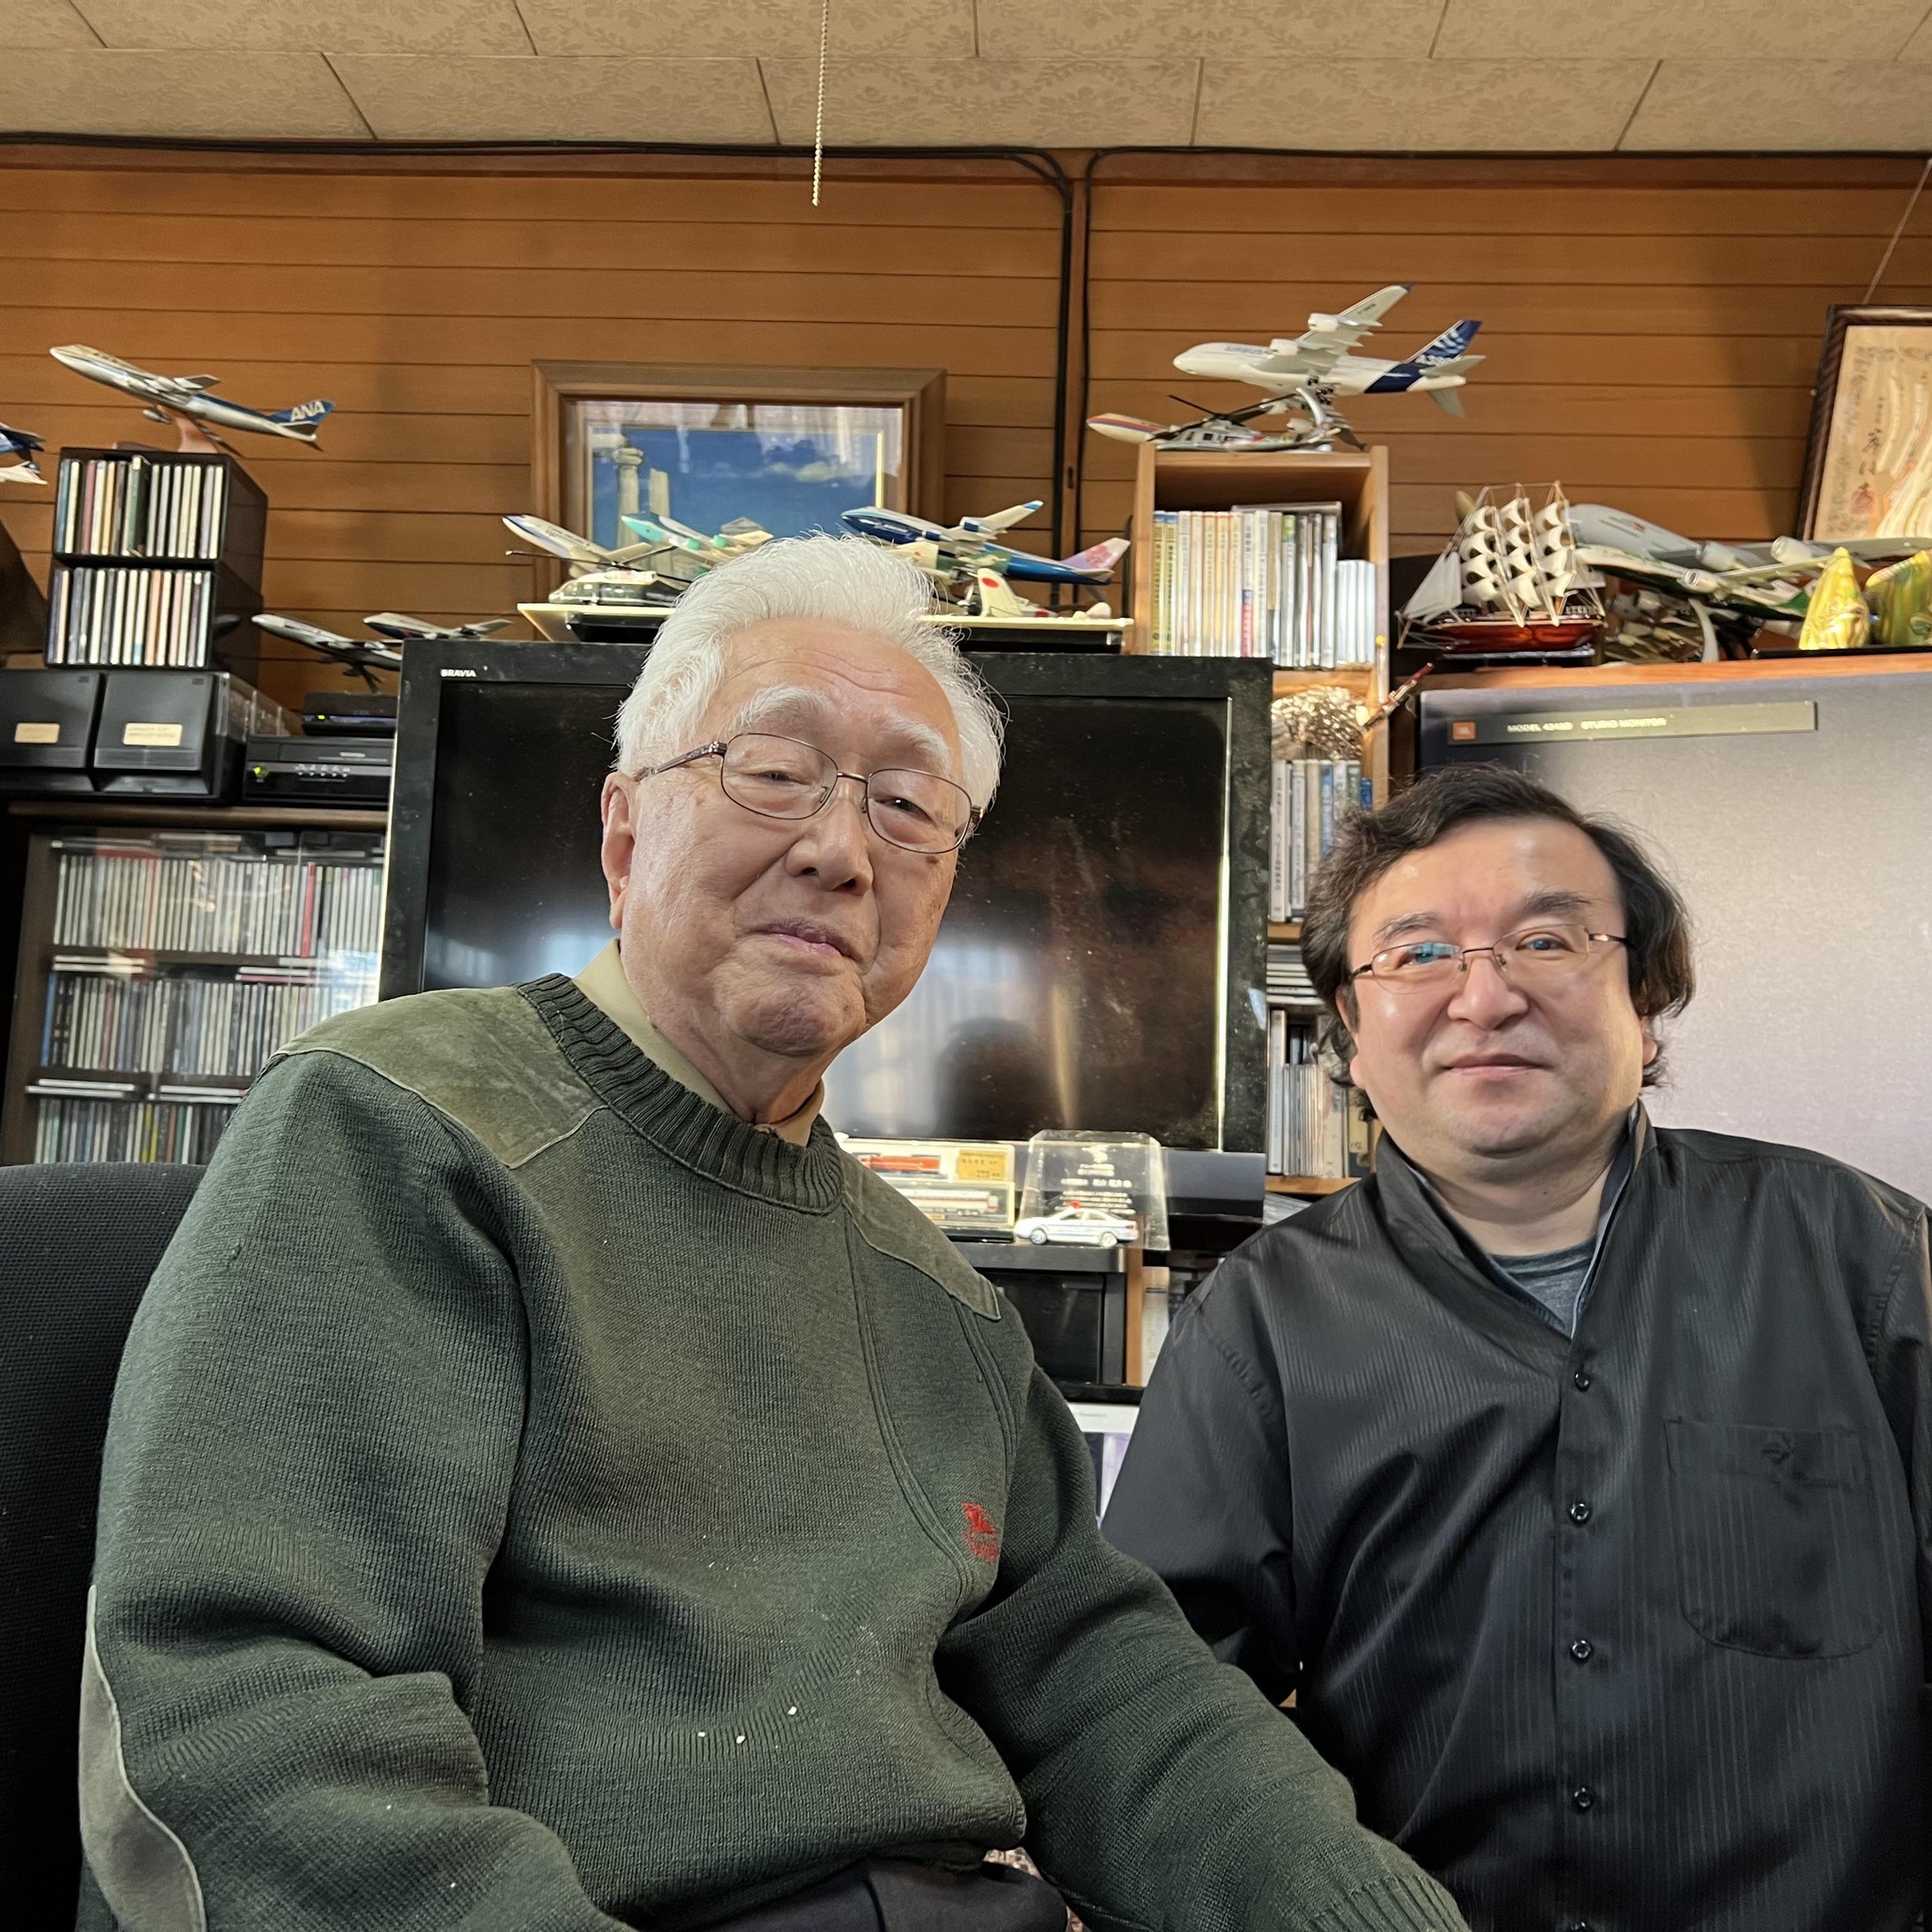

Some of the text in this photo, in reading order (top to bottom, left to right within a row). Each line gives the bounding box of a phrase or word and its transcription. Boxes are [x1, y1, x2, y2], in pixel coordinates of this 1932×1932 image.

[291, 401, 326, 422] ANA
[441, 669, 476, 677] BRAVIA
[1507, 723, 1542, 733] MODEL
[1619, 717, 1667, 728] MONITOR
